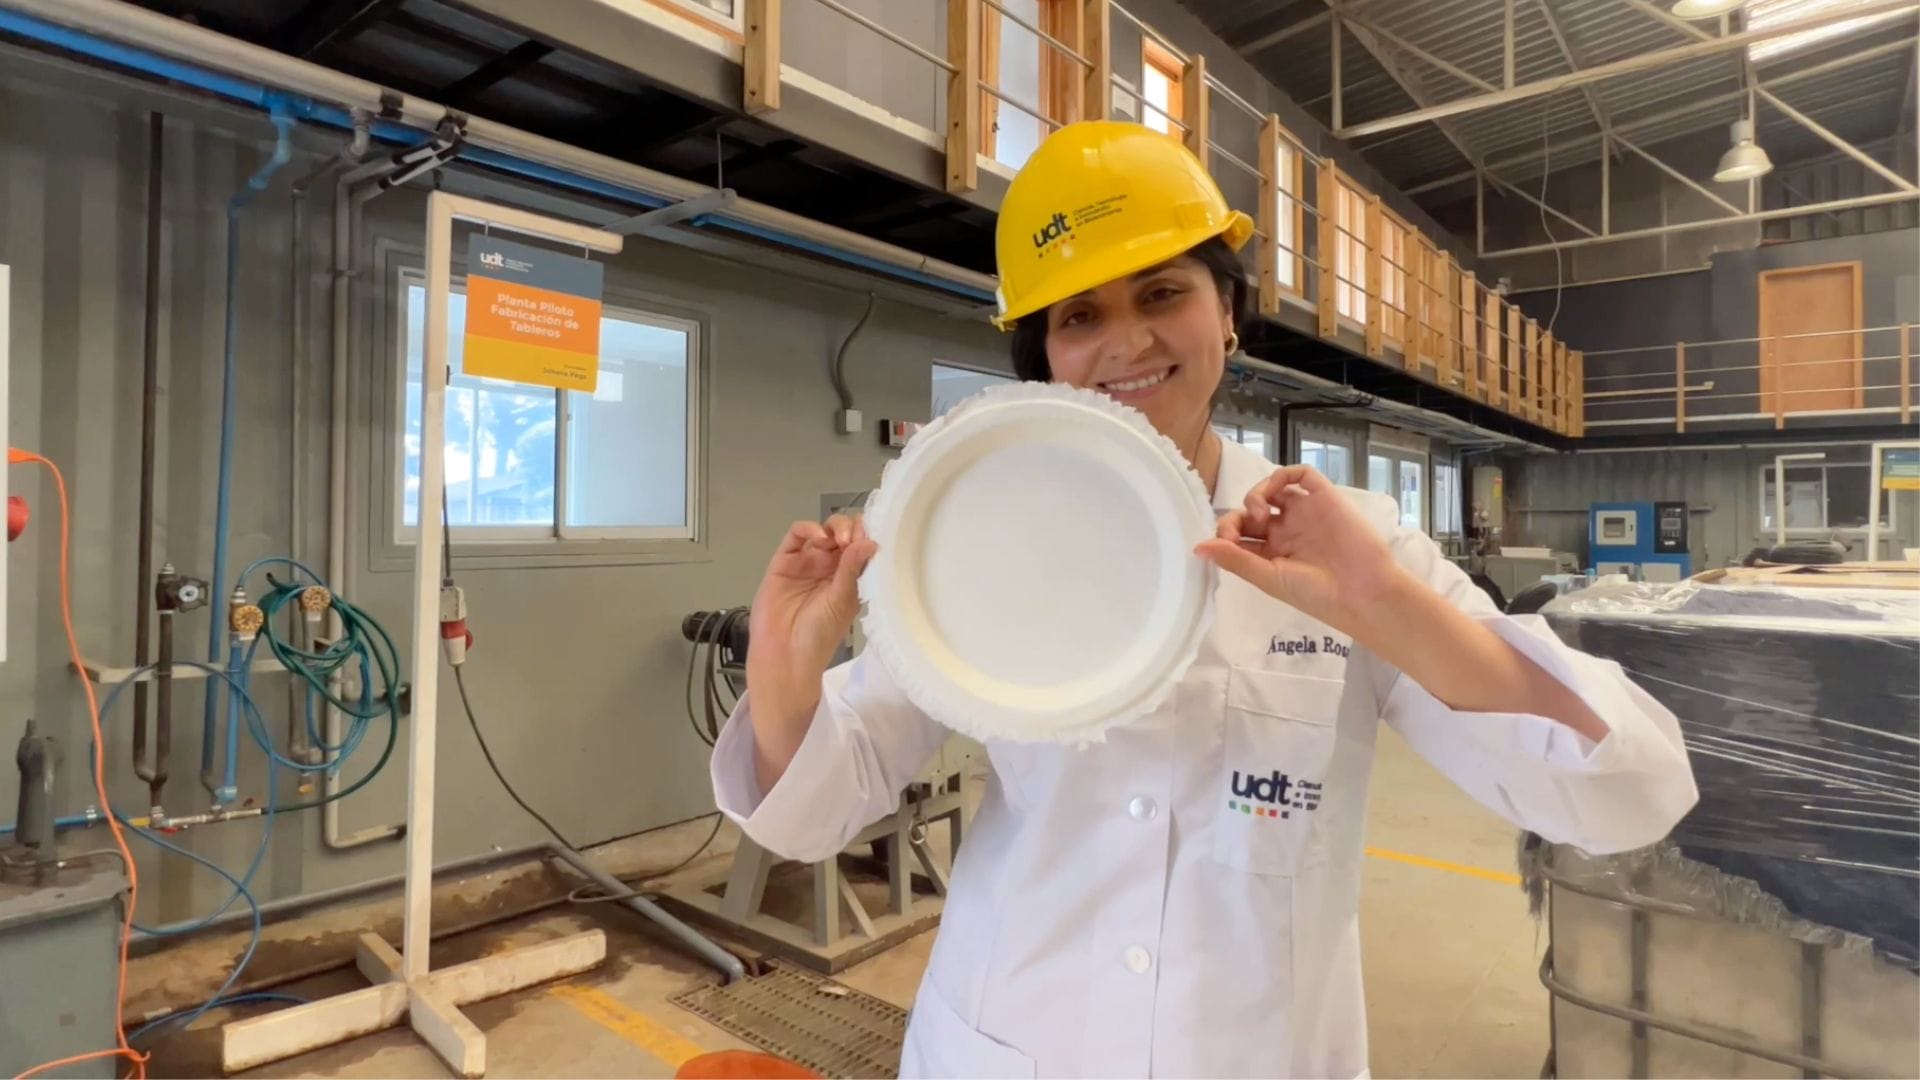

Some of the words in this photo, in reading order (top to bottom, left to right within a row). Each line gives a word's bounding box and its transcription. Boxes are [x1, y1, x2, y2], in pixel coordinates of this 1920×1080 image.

[1032, 212, 1072, 248] udt
[480, 252, 505, 268] udt
[490, 304, 562, 327] Fabricación
[564, 318, 579, 330] de
[497, 293, 537, 310] Planta
[540, 301, 575, 317] Piloto
[511, 320, 561, 338] Tableros
[1266, 635, 1317, 656] Ángela
[1231, 770, 1293, 805] udt
